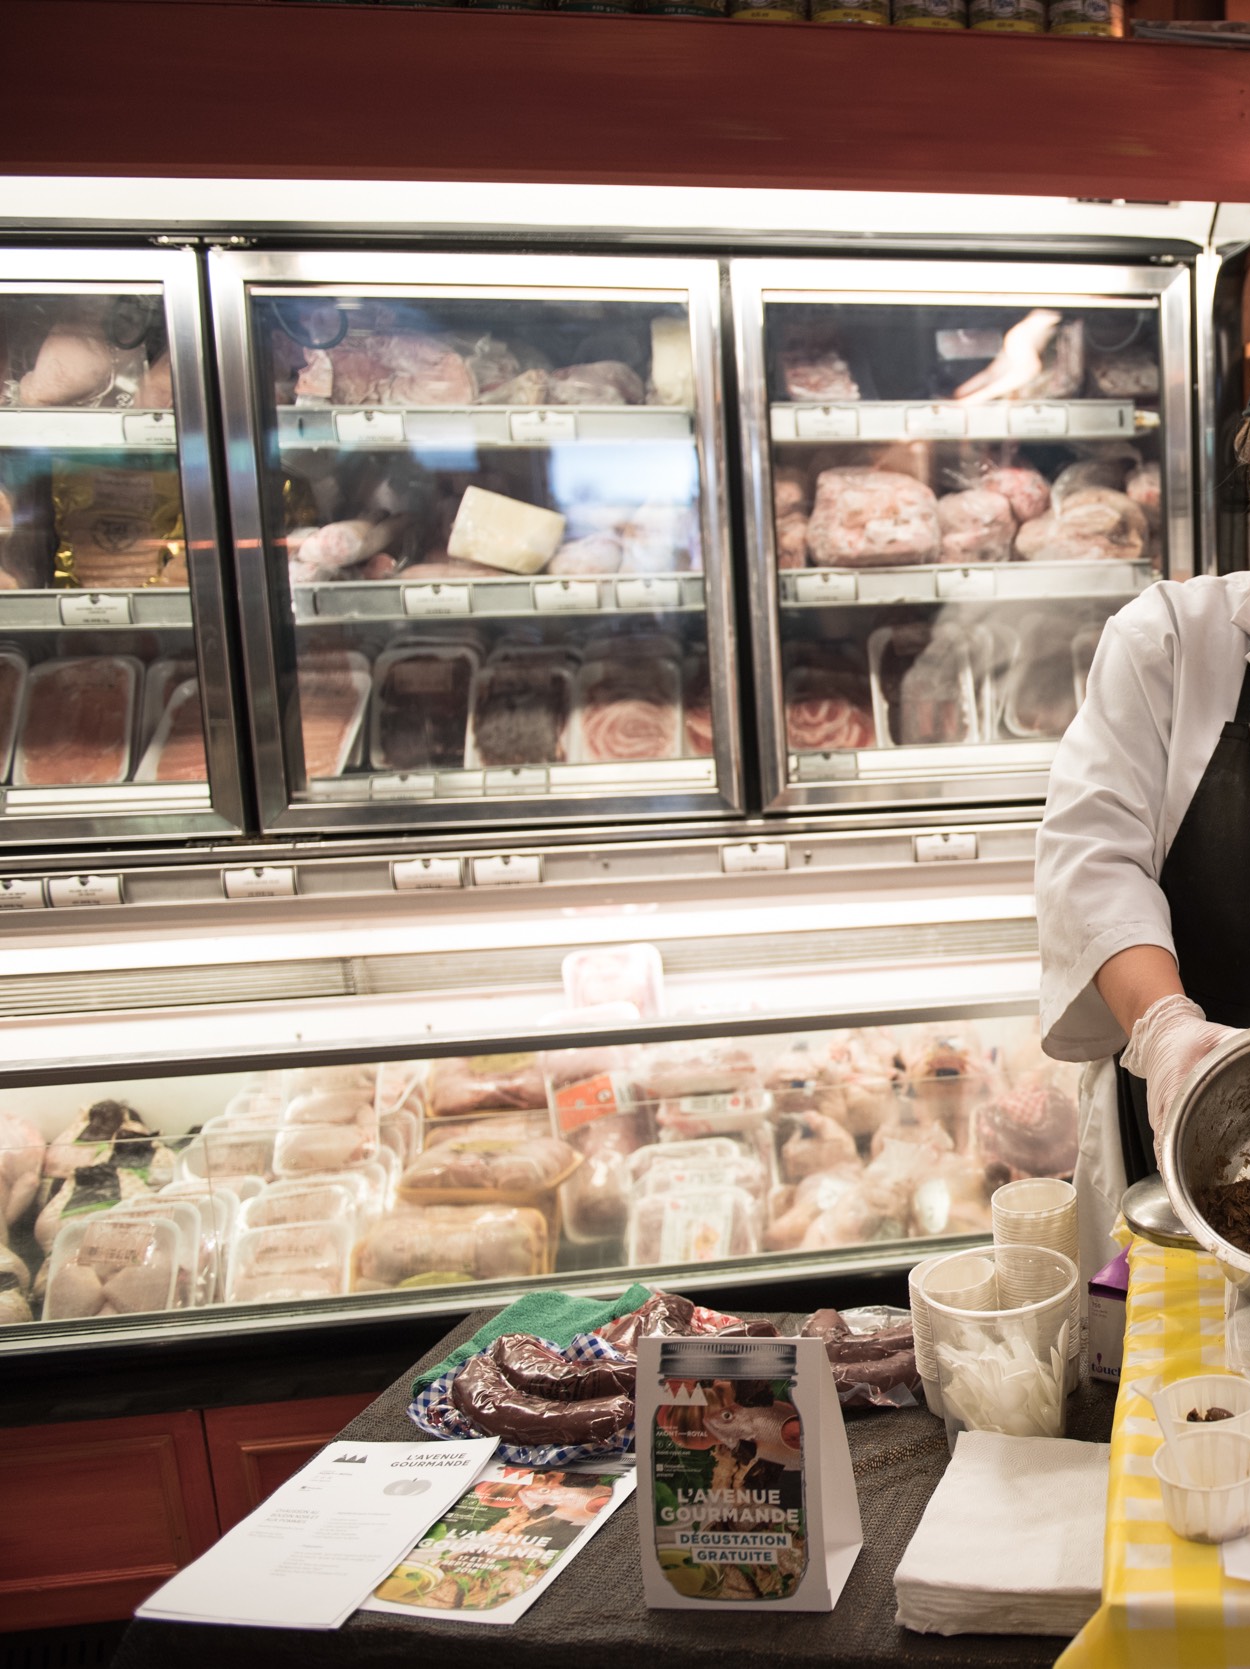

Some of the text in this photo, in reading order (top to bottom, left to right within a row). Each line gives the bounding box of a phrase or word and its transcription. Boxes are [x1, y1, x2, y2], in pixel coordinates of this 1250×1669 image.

[677, 1488, 781, 1505] L'AVENUE
[660, 1506, 799, 1523] GOURMANDE
[446, 1528, 552, 1547] L'AVENUE
[680, 1532, 787, 1545] DÉGUSTATION
[417, 1538, 560, 1560] GOURMANDE
[697, 1551, 772, 1561] GRATUITE
